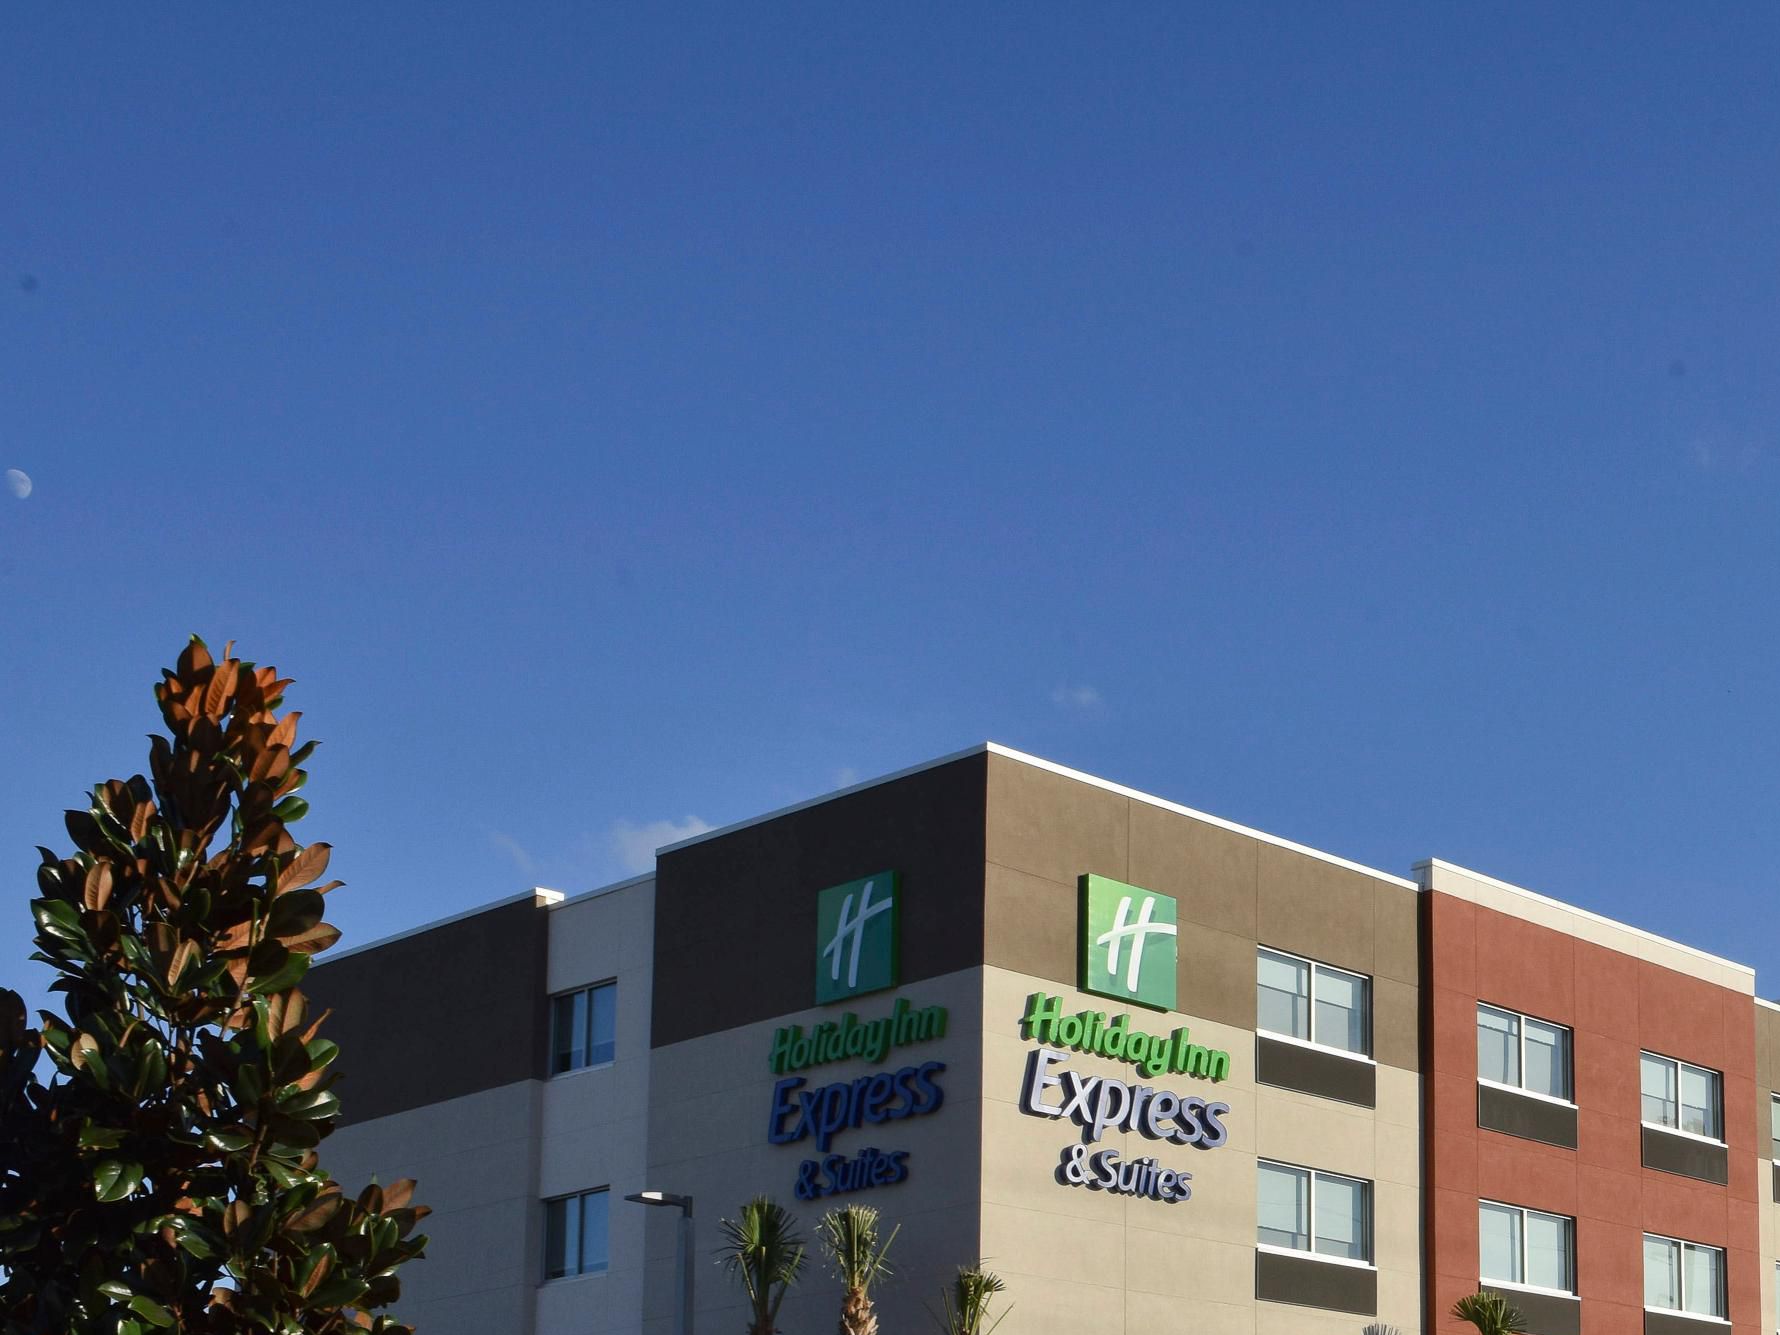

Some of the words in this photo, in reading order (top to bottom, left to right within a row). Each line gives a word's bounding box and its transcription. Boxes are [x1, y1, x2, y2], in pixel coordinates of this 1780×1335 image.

[769, 1012, 892, 1074] Holiday
[889, 998, 948, 1047] Inn
[1024, 991, 1173, 1077] Holiday
[1173, 1027, 1231, 1082] Inn
[768, 1061, 946, 1152] Express
[1026, 1047, 1230, 1149] Express
[795, 1159, 822, 1200] &
[820, 1147, 911, 1197] Suites
[1062, 1143, 1091, 1185] &
[1095, 1149, 1193, 1202] Suites
